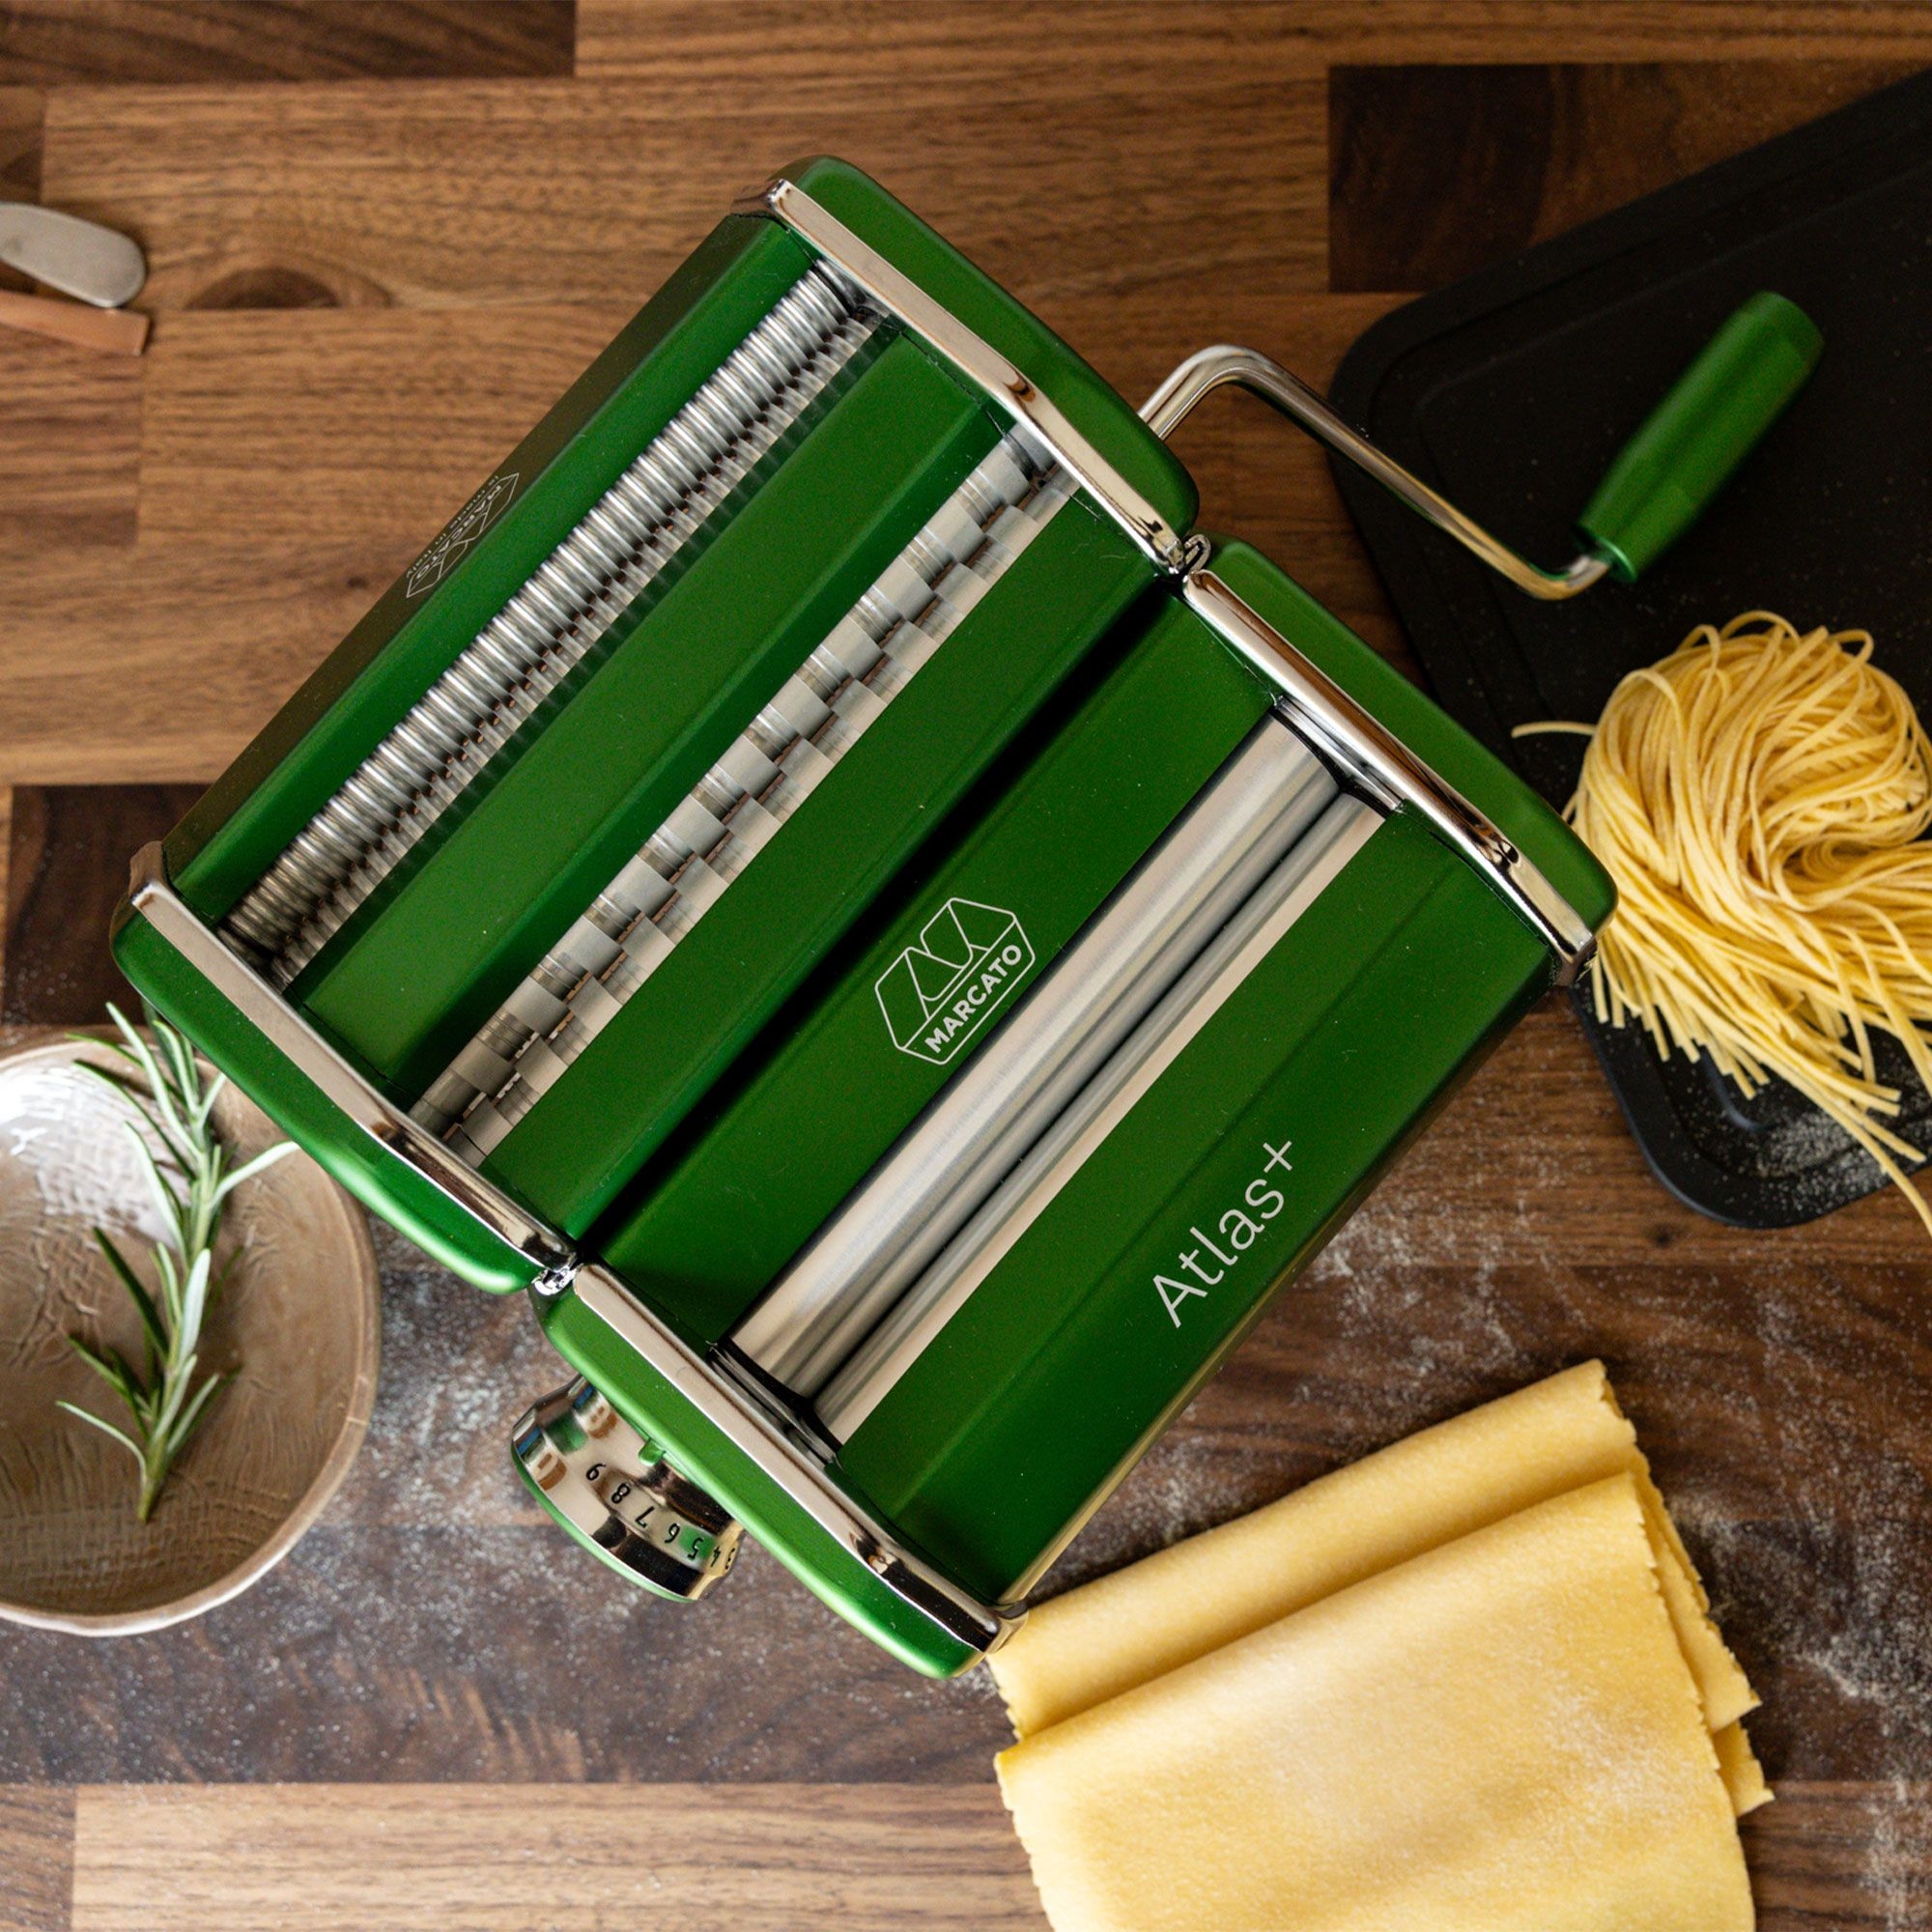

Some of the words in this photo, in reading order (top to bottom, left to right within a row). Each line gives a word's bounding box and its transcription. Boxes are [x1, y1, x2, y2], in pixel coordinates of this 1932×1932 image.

[416, 485, 501, 580] MARCATO
[406, 548, 433, 579] Italy
[923, 944, 1023, 1054] MARCATO
[1152, 1140, 1293, 1329] Atlas+
[585, 1463, 607, 1481] 9
[611, 1482, 631, 1504] 8
[635, 1505, 656, 1528] 7
[664, 1522, 681, 1544] 6
[687, 1537, 704, 1561] 5
[710, 1546, 722, 1568] 4
